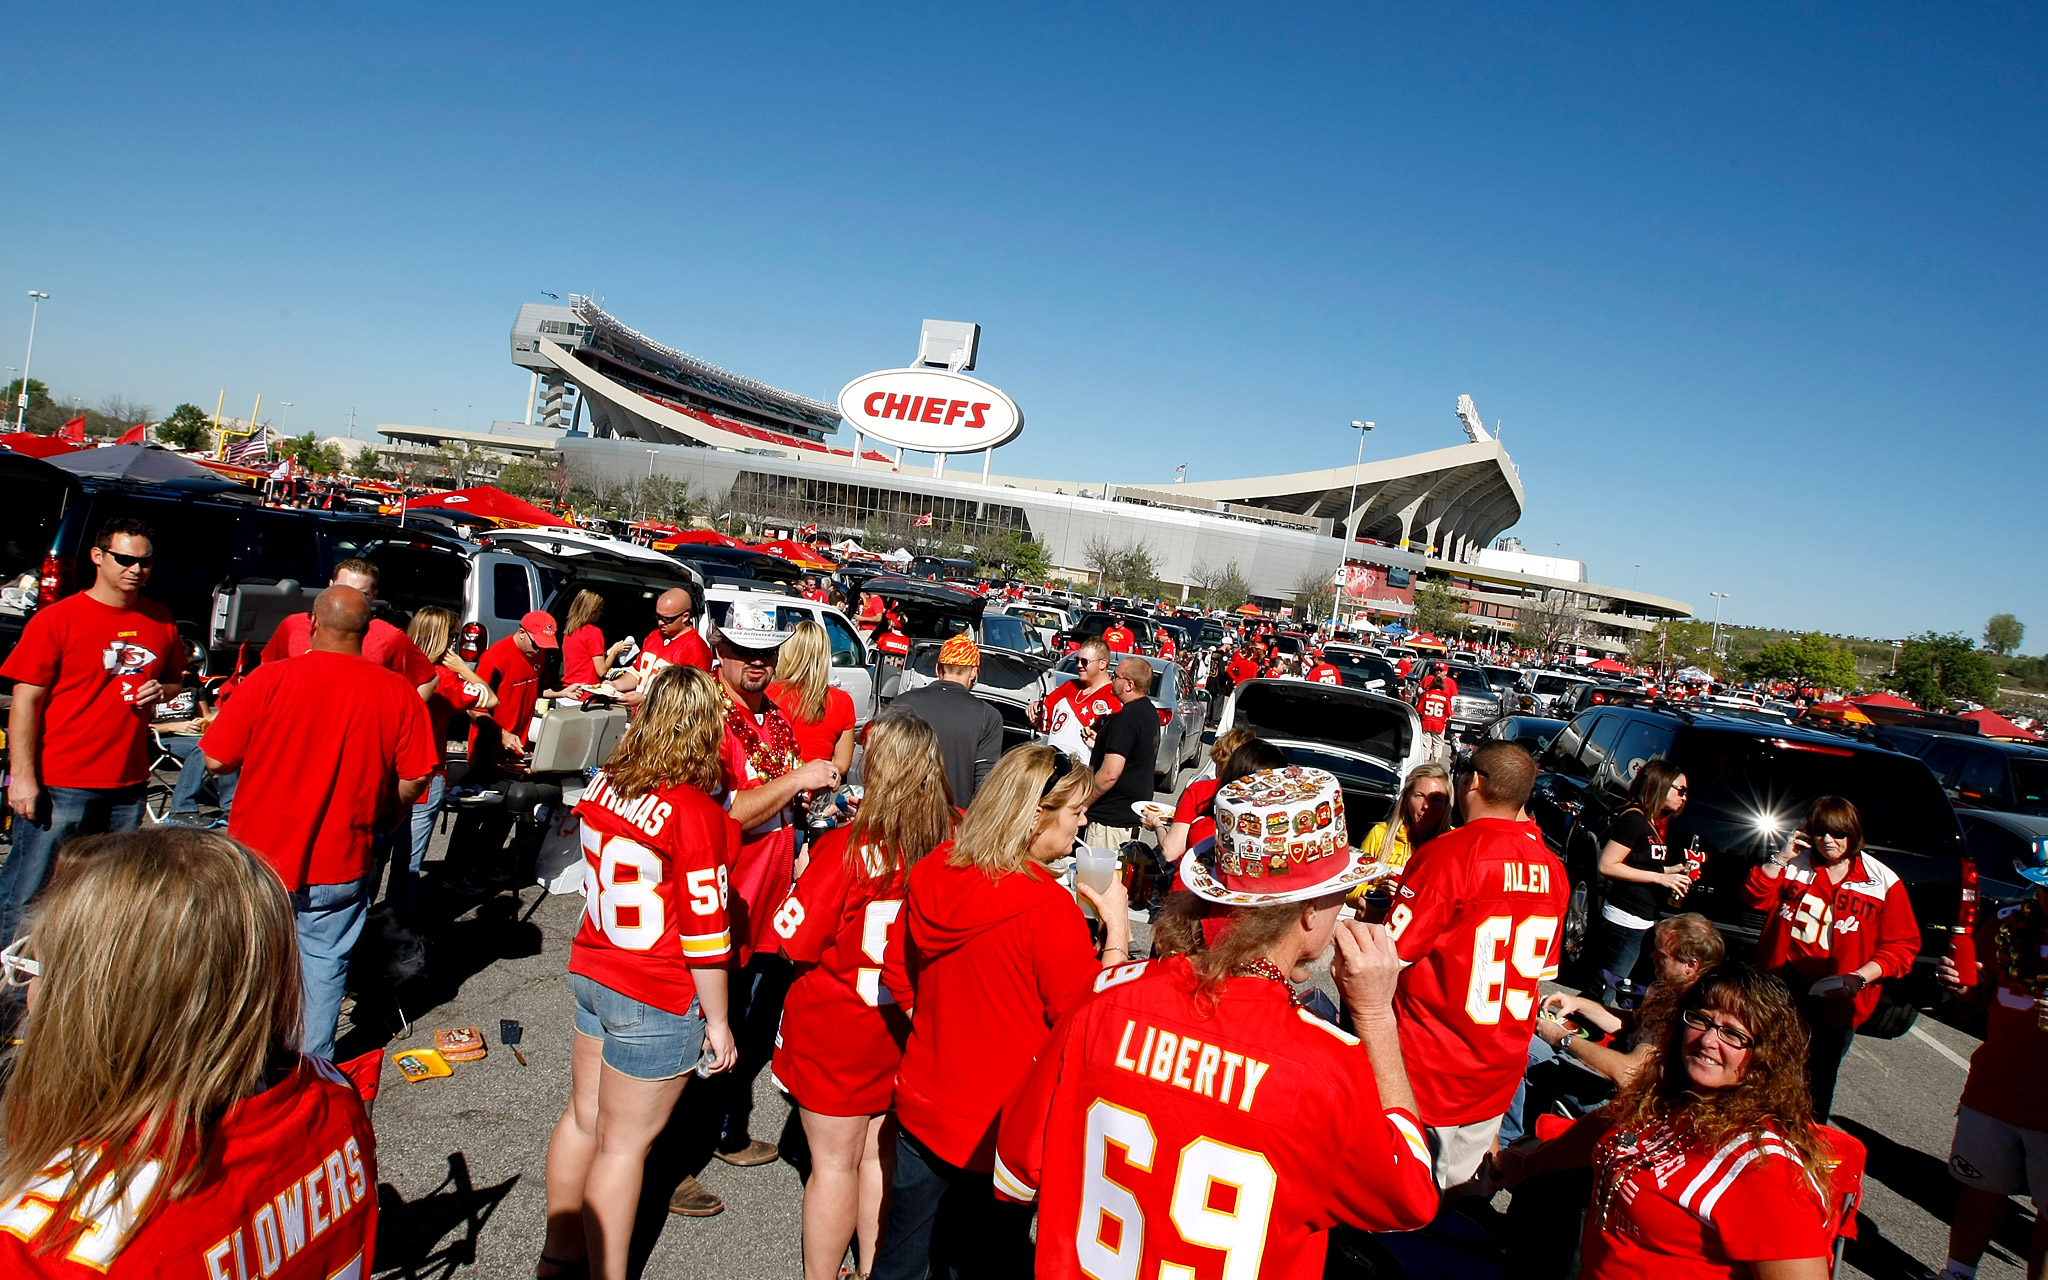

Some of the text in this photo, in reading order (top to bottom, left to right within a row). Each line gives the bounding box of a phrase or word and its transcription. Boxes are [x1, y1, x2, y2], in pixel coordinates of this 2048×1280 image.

[864, 391, 991, 429] CHIEFS
[1337, 569, 1345, 577] C
[1424, 701, 1444, 718] 56
[579, 815, 665, 951] 58
[686, 863, 728, 917] 58
[1503, 862, 1550, 894] ALLEN
[1465, 914, 1559, 1026] 69
[1114, 1019, 1271, 1113] LIBERTY
[202, 1135, 367, 1280] FLOWERS
[1075, 1096, 1278, 1280] 69
